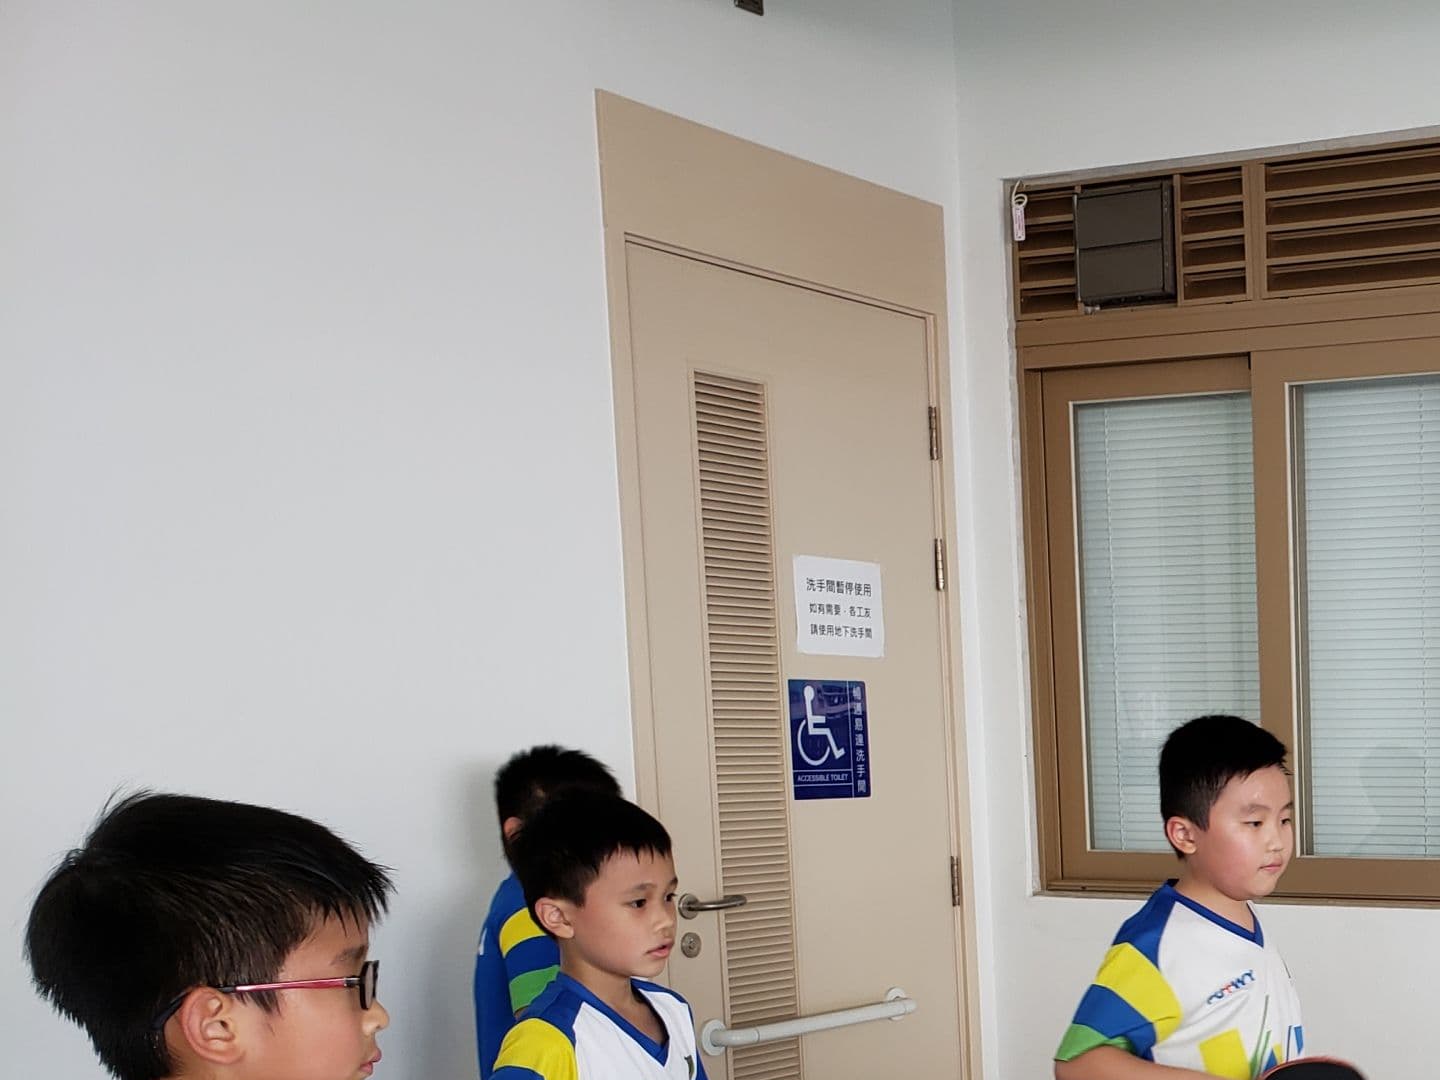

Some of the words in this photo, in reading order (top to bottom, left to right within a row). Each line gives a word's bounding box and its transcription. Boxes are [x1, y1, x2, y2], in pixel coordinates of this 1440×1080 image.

[806, 577, 872, 597] 洗手間暫停使用
[797, 774, 829, 782] ACCESSIBLE
[831, 773, 848, 781] TOILET
